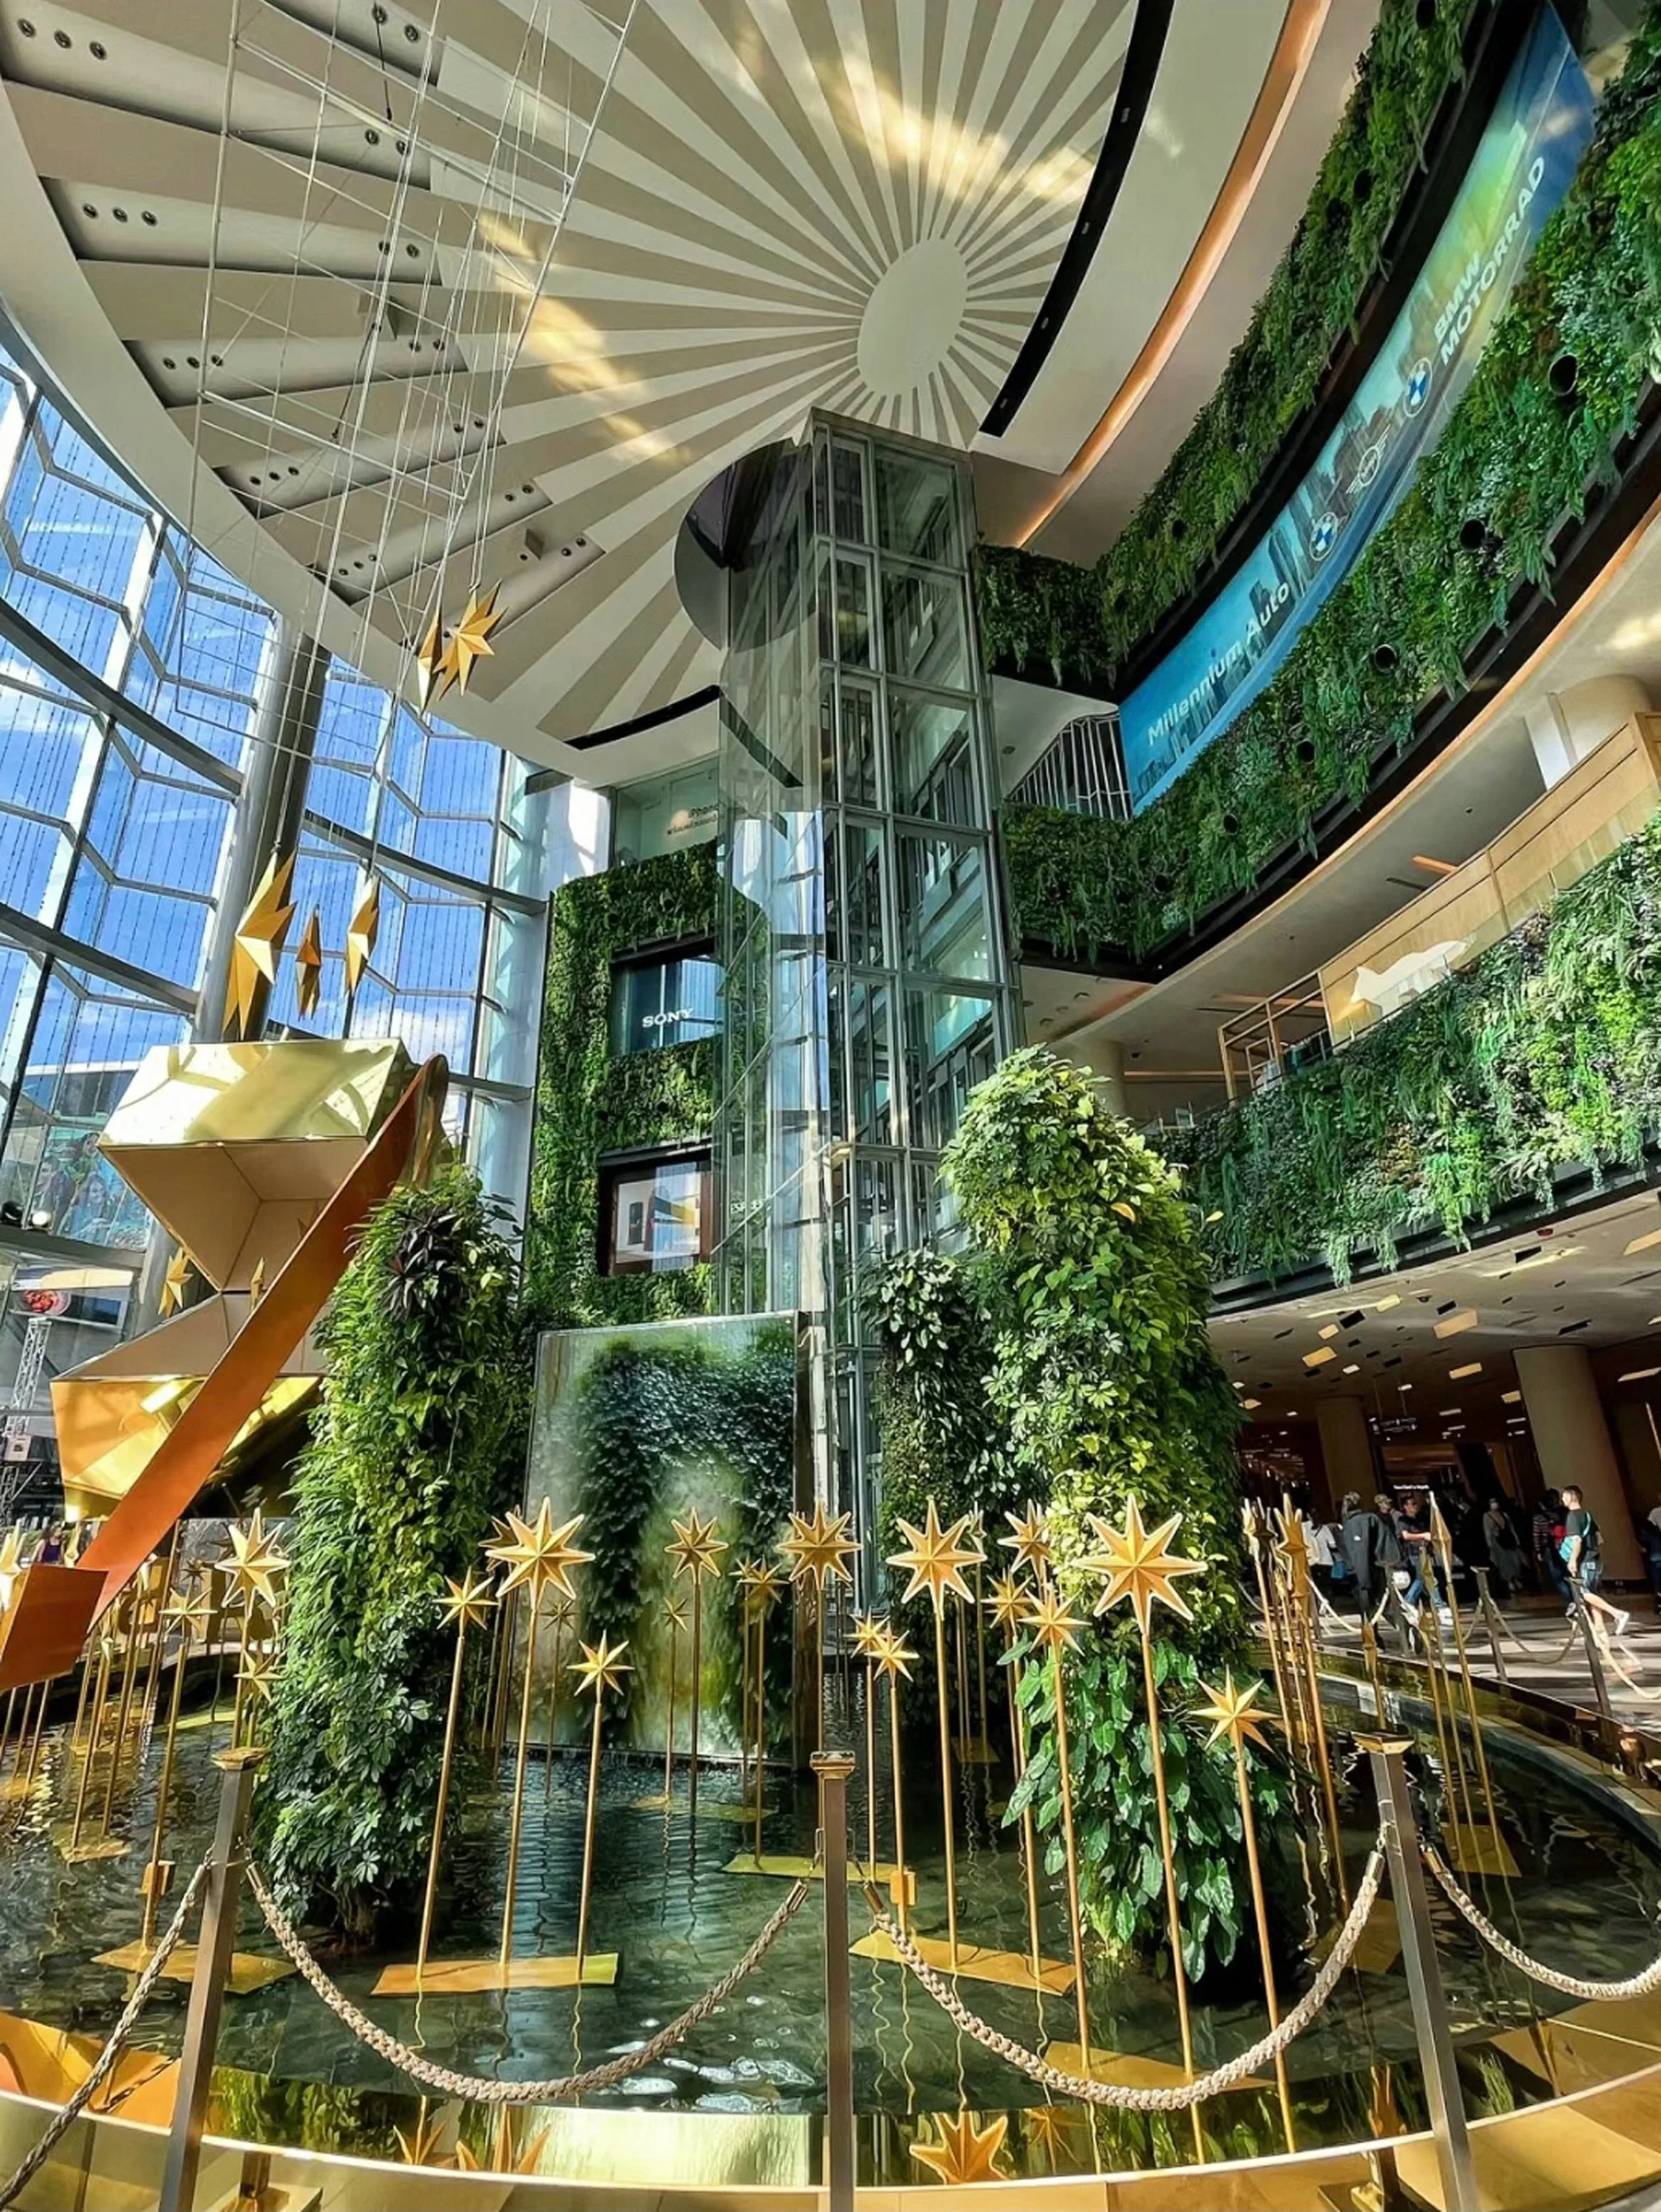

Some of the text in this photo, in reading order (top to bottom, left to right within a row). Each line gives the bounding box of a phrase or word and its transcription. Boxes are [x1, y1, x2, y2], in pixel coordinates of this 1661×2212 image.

[1434, 250, 1480, 344] BMW
[1440, 156, 1545, 366] MOTORRAD
[1148, 582, 1289, 747] Millennium Auto
[642, 1007, 695, 1028] SONY
